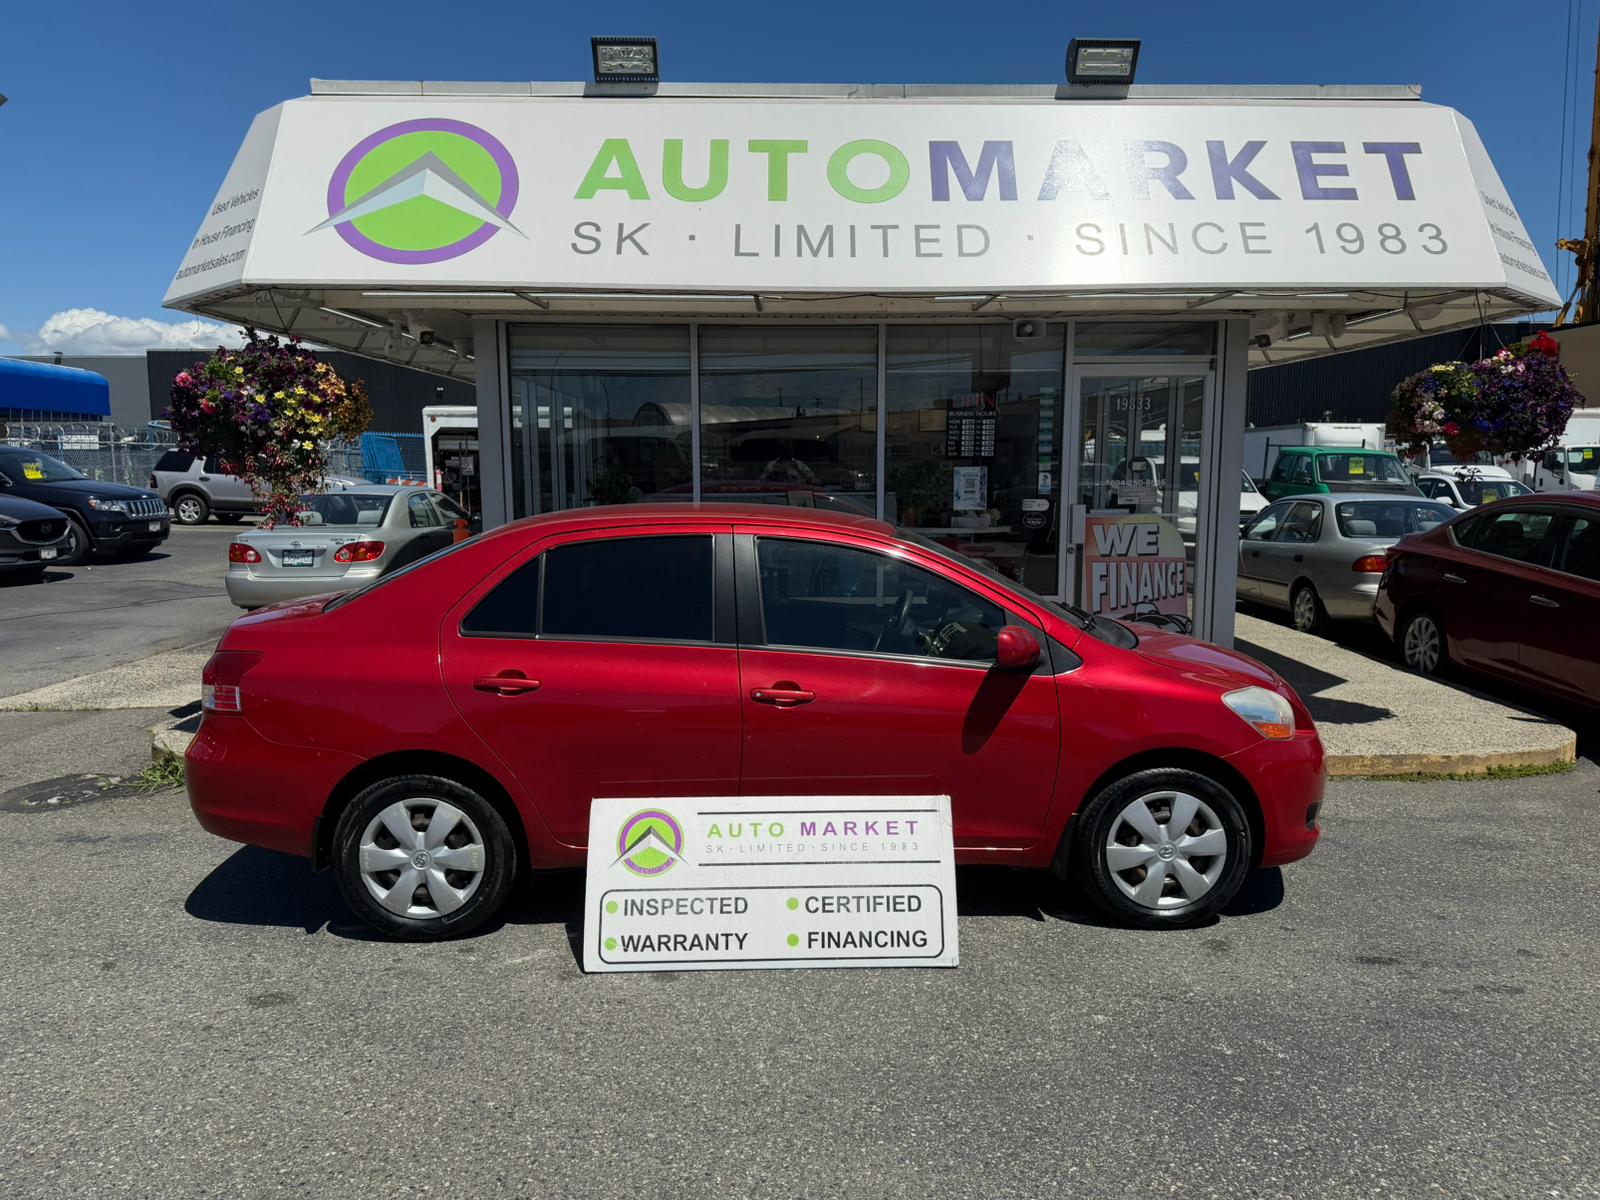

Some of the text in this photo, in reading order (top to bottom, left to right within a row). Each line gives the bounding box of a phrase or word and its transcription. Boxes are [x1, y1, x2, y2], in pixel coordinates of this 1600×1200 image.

[211, 188, 260, 216] Used Vehicles
[191, 218, 256, 250] In House Financing
[571, 221, 1450, 258] SK LIMITED SINCE 1983
[175, 248, 246, 280] automarketsales.com
[953, 393, 996, 408] OPEN
[1115, 397, 1151, 411] 19833
[1091, 523, 1160, 557] WE
[1091, 561, 1184, 614] FINANCE
[707, 820, 919, 839] AUTO MARKET
[705, 841, 920, 854] SK LIMITED SINCE 1983
[623, 896, 749, 917] INSPECTED
[804, 894, 922, 914] CERTIFIED
[620, 933, 749, 953] WARRANTY
[807, 930, 928, 950] FINANCING
